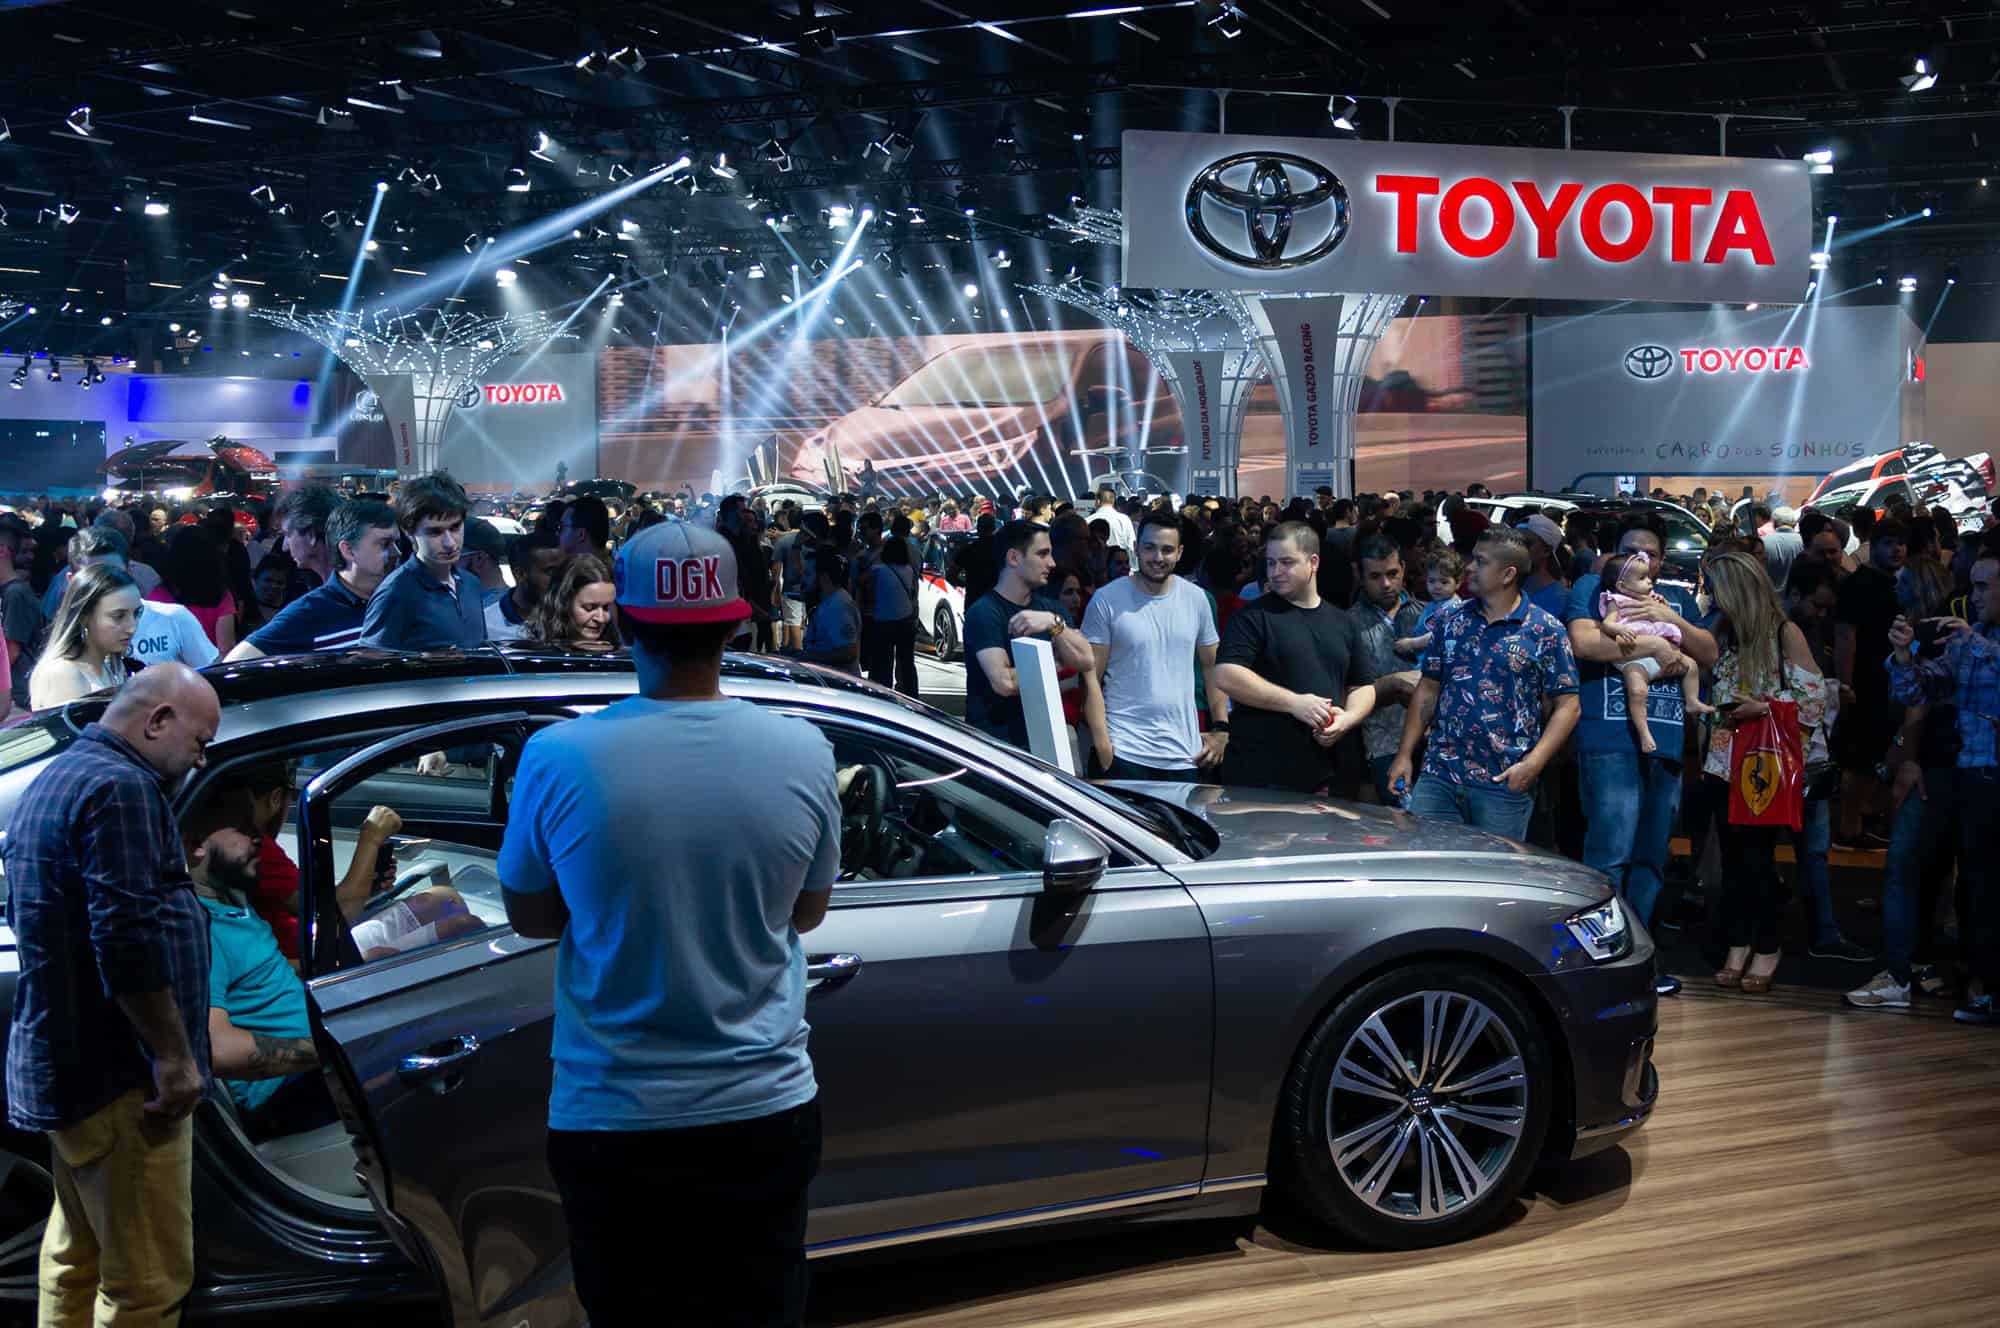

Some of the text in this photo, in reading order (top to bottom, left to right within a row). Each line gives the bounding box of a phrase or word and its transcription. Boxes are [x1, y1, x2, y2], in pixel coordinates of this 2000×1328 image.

[1376, 174, 1776, 265] TOYOTA
[1301, 322, 1312, 362] RACING
[1680, 347, 1809, 373] TOYOTA
[484, 384, 562, 404] TOYOTA
[1308, 402, 1319, 448] TOYOTA
[1655, 440, 1731, 461] CARRO
[1769, 440, 1865, 458] SONHOS
[655, 554, 725, 602] DGK
[138, 635, 168, 655] ONE
